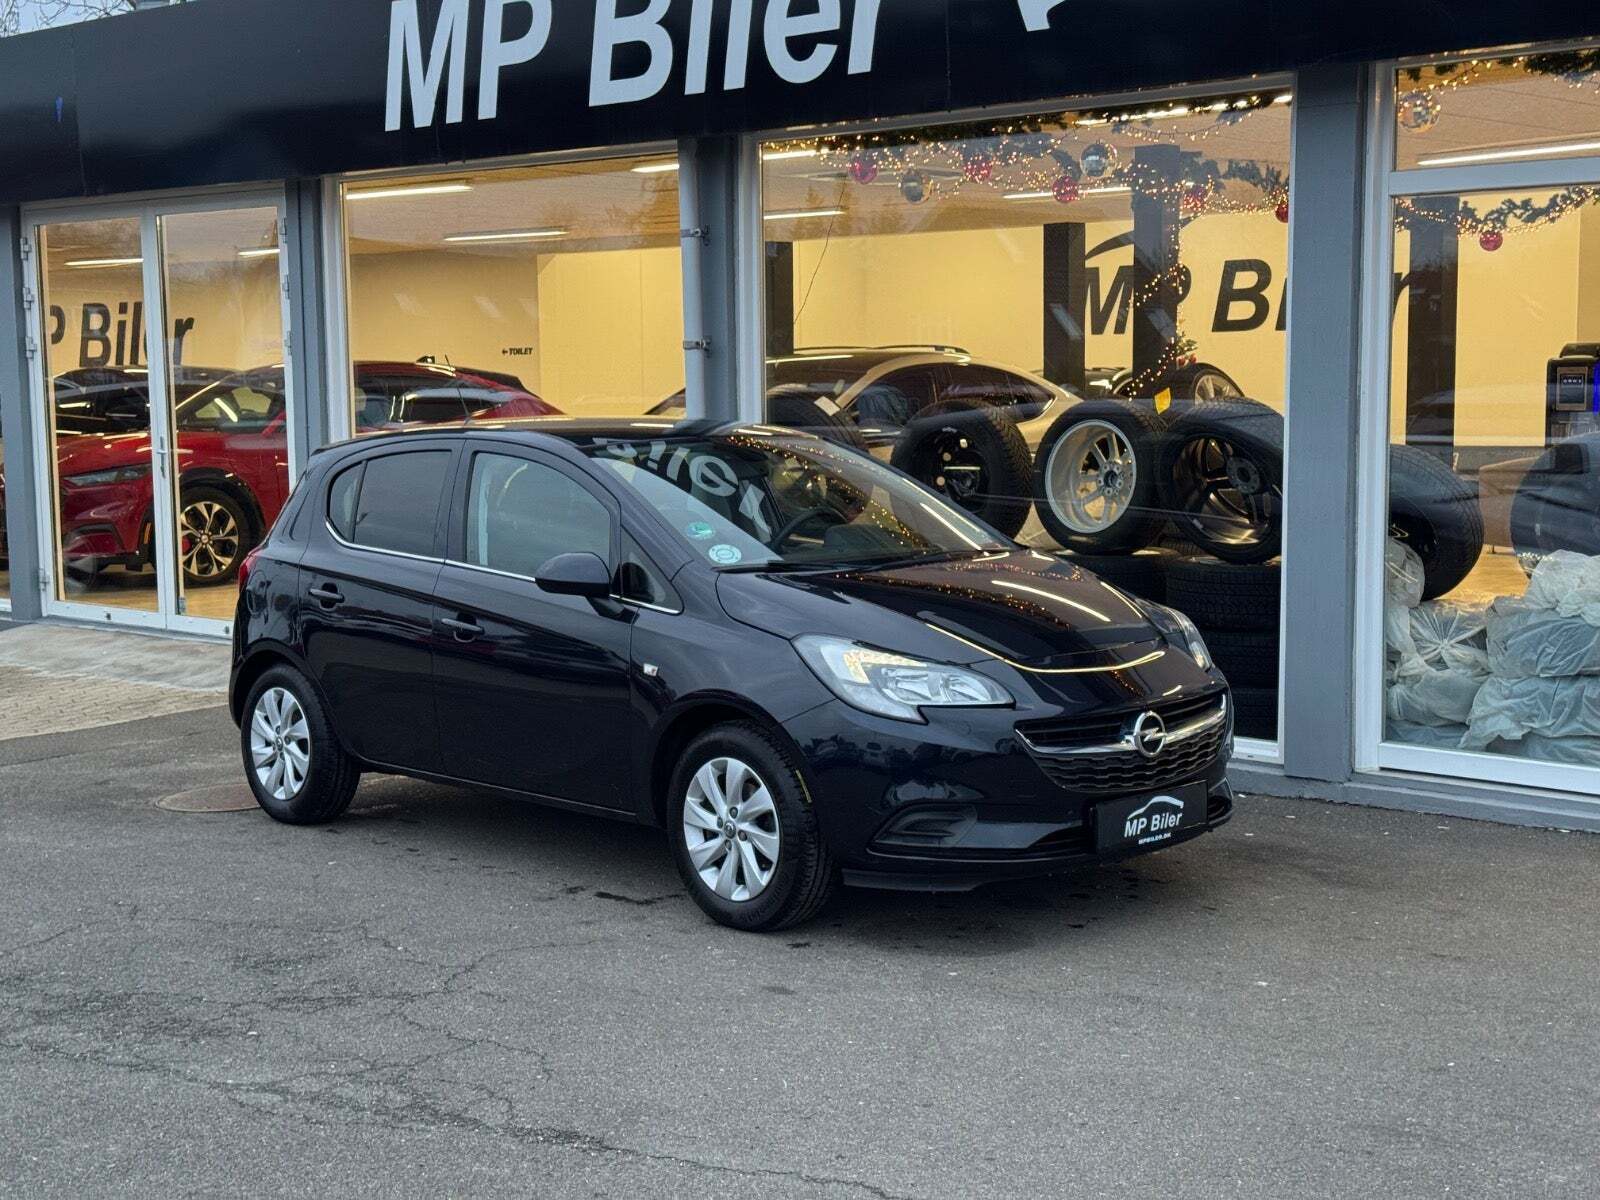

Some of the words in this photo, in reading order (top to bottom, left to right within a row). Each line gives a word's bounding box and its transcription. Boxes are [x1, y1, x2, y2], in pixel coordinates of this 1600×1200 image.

[384, 0, 552, 132] MP
[79, 301, 195, 368] Bilr
[508, 347, 534, 356] TOILET
[1124, 817, 1148, 838] MP
[1150, 812, 1183, 832] Biler
